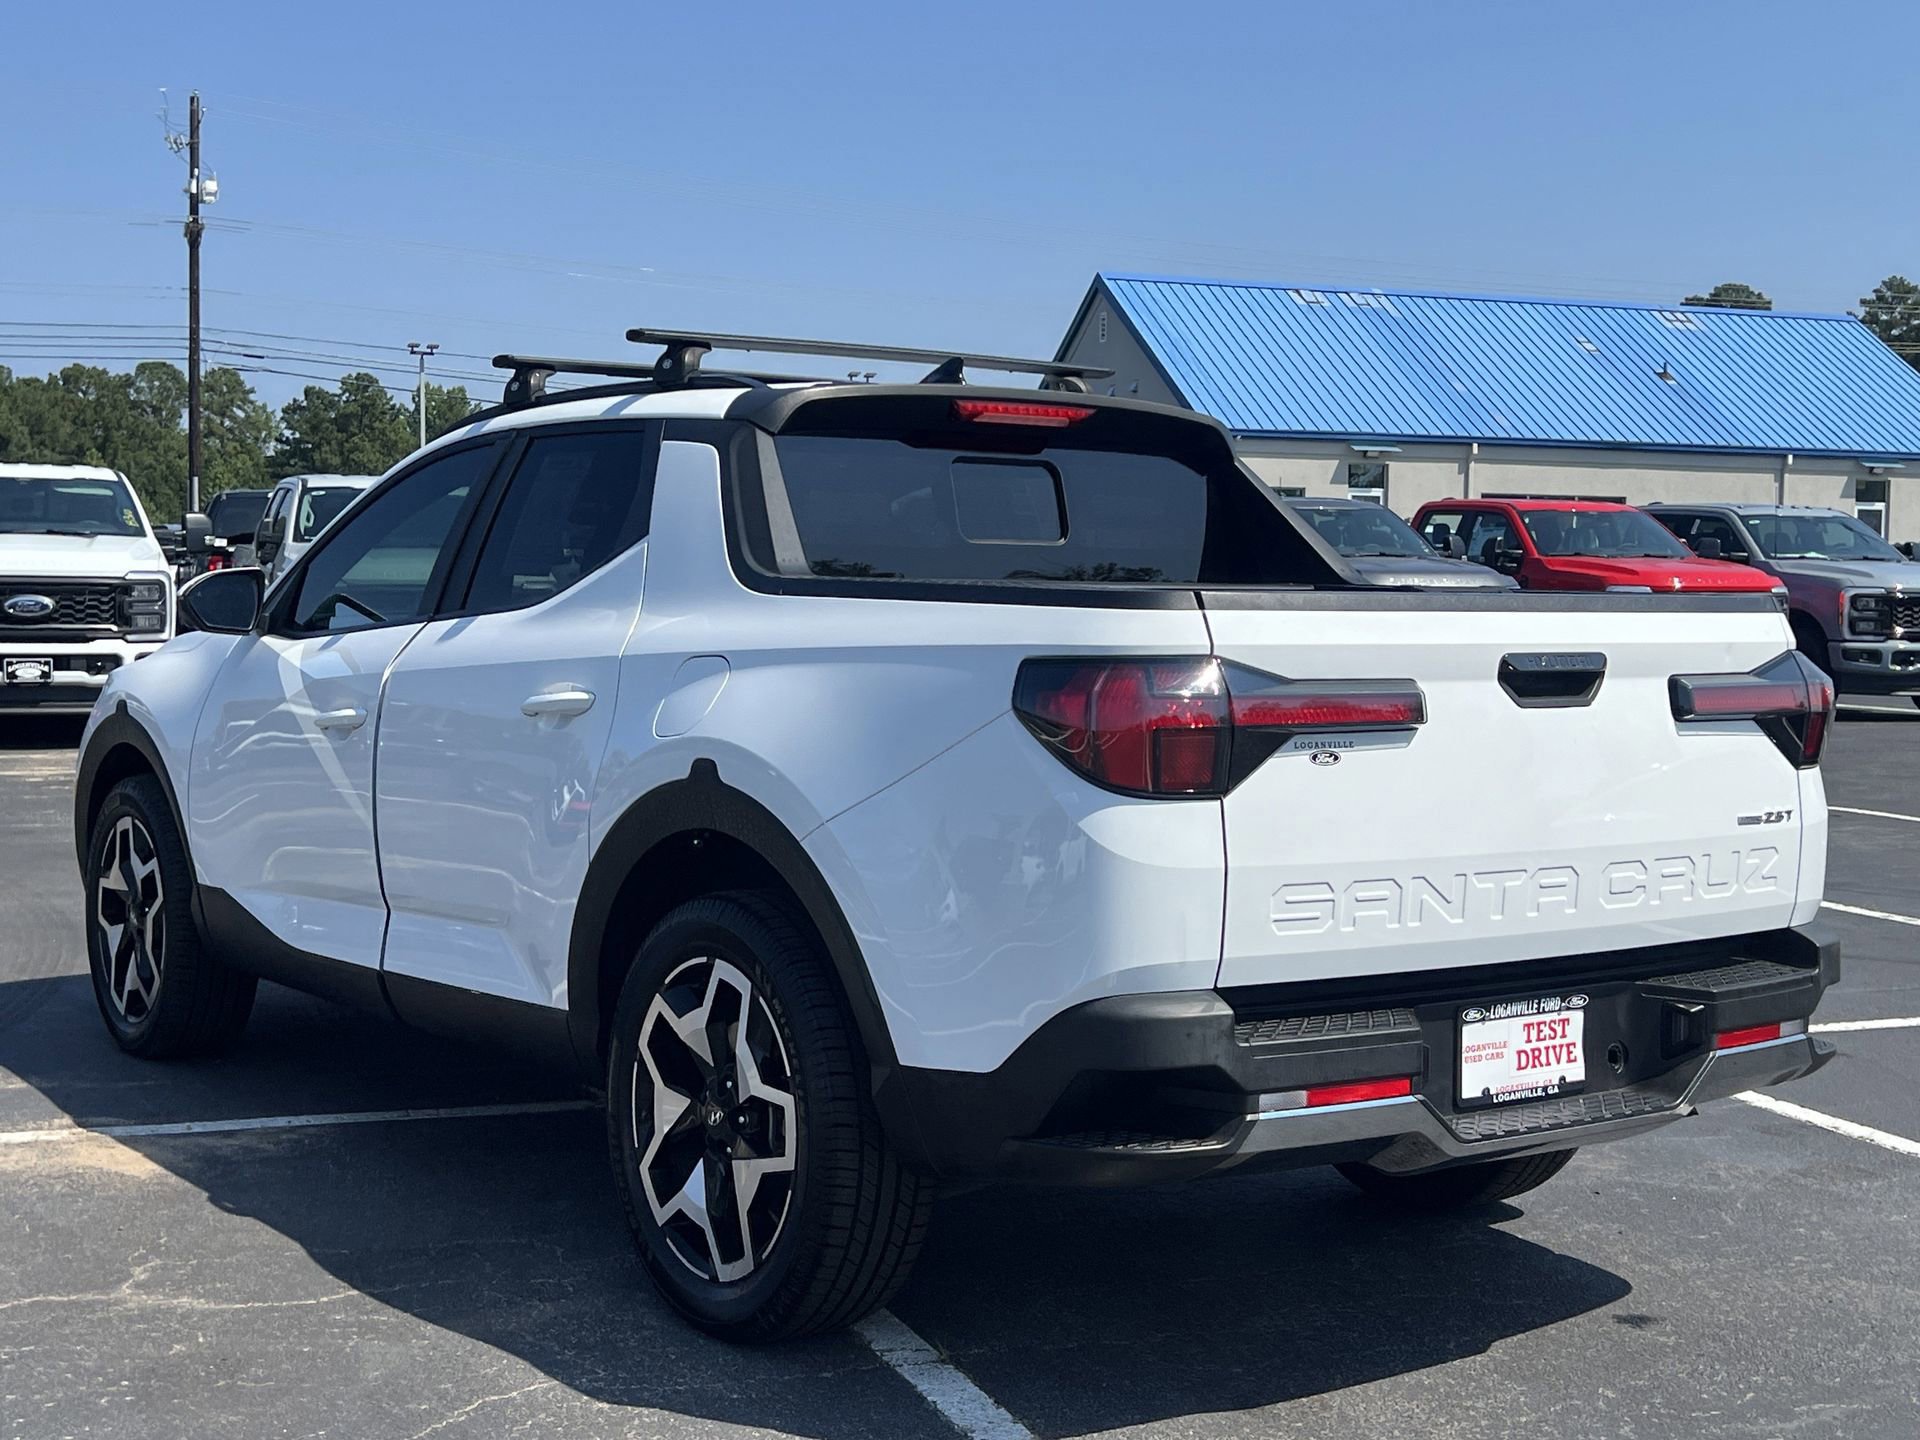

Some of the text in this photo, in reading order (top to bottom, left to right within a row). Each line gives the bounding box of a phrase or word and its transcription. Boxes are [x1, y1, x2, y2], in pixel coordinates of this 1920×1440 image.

[1294, 741, 1354, 749] LOGANVILLE
[1270, 846, 1780, 935] SANTA CRUZ
[1490, 997, 1561, 1018] LOGANVILLE FORD
[1523, 1018, 1570, 1044] TEST
[1463, 1041, 1508, 1053] OGANVILLE
[1516, 1042, 1577, 1071] DRIVE
[1464, 1051, 1505, 1064] USED CARS
[1493, 1085, 1559, 1103] LOGANVILLE, GA
